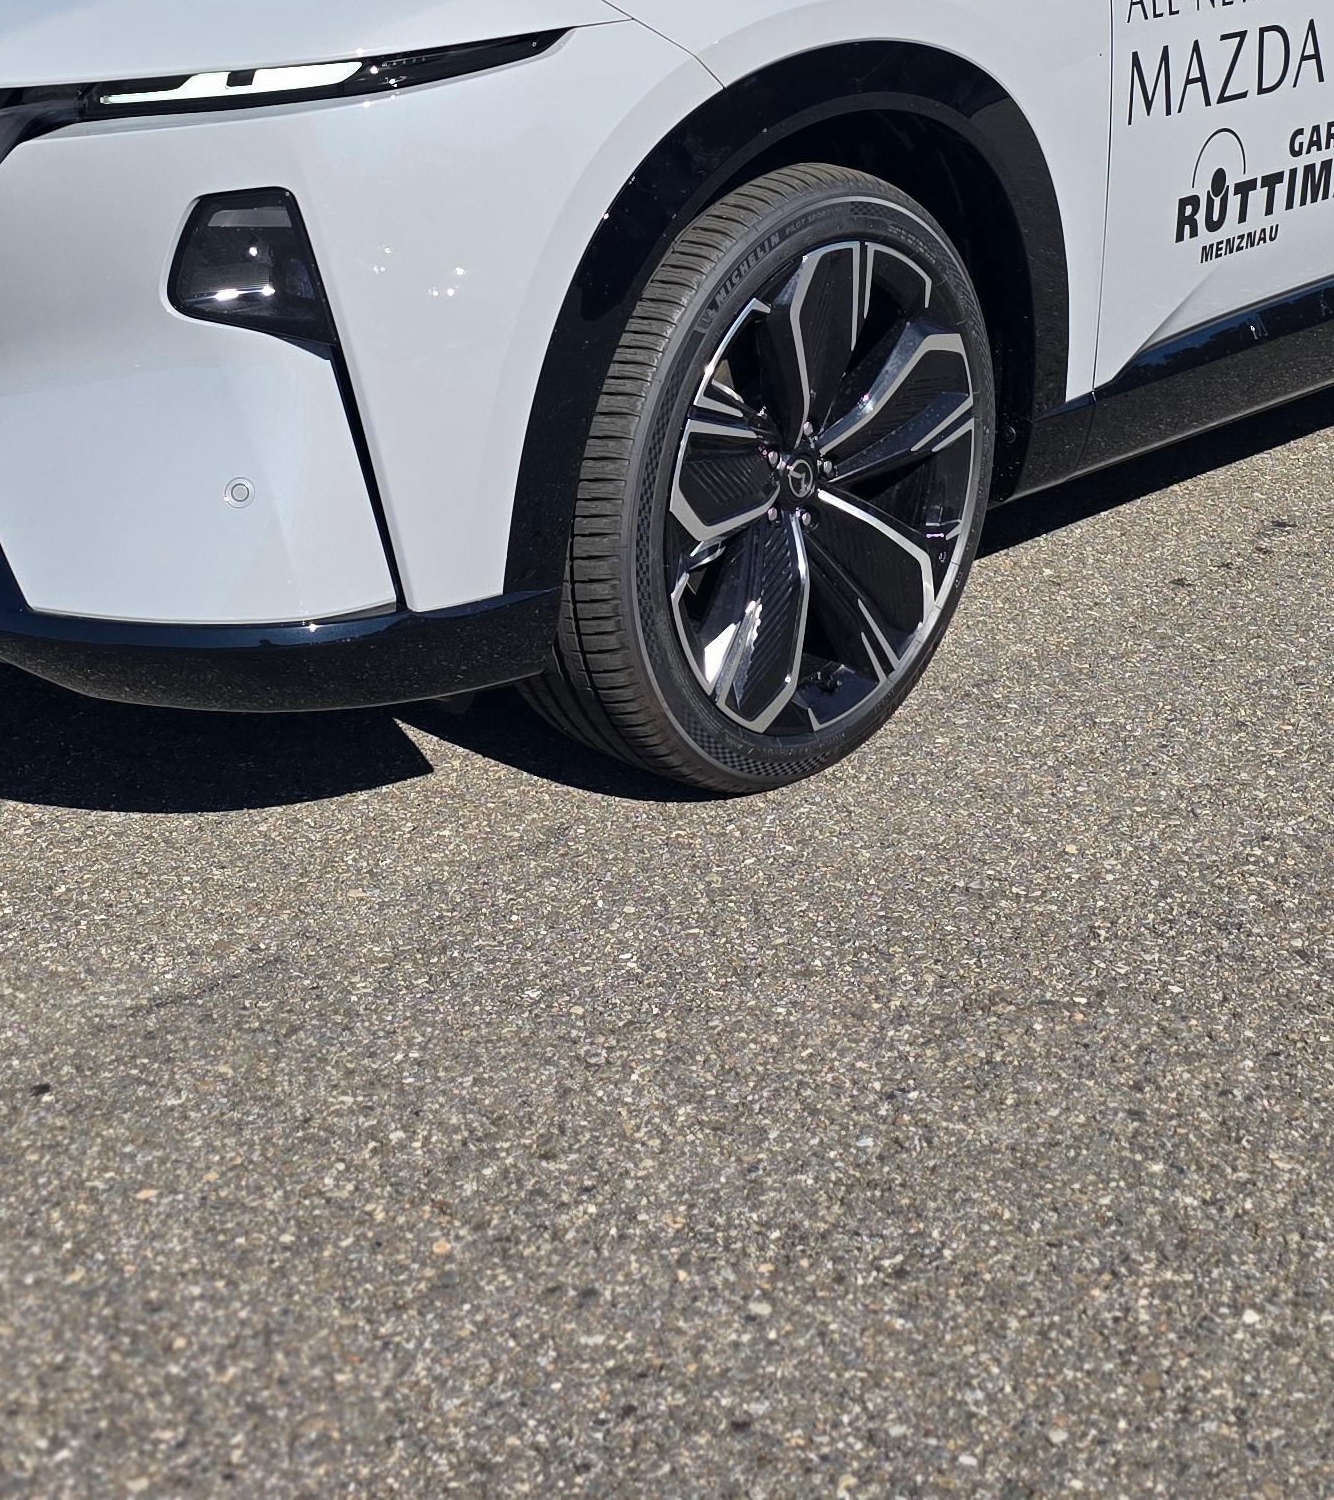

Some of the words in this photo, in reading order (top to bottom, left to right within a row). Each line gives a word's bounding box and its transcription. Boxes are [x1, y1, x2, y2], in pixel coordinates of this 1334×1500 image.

[1127, 18, 1325, 126] MAZDA
[714, 231, 781, 307] MICHELIN
[1200, 223, 1280, 264] MENZNAU
